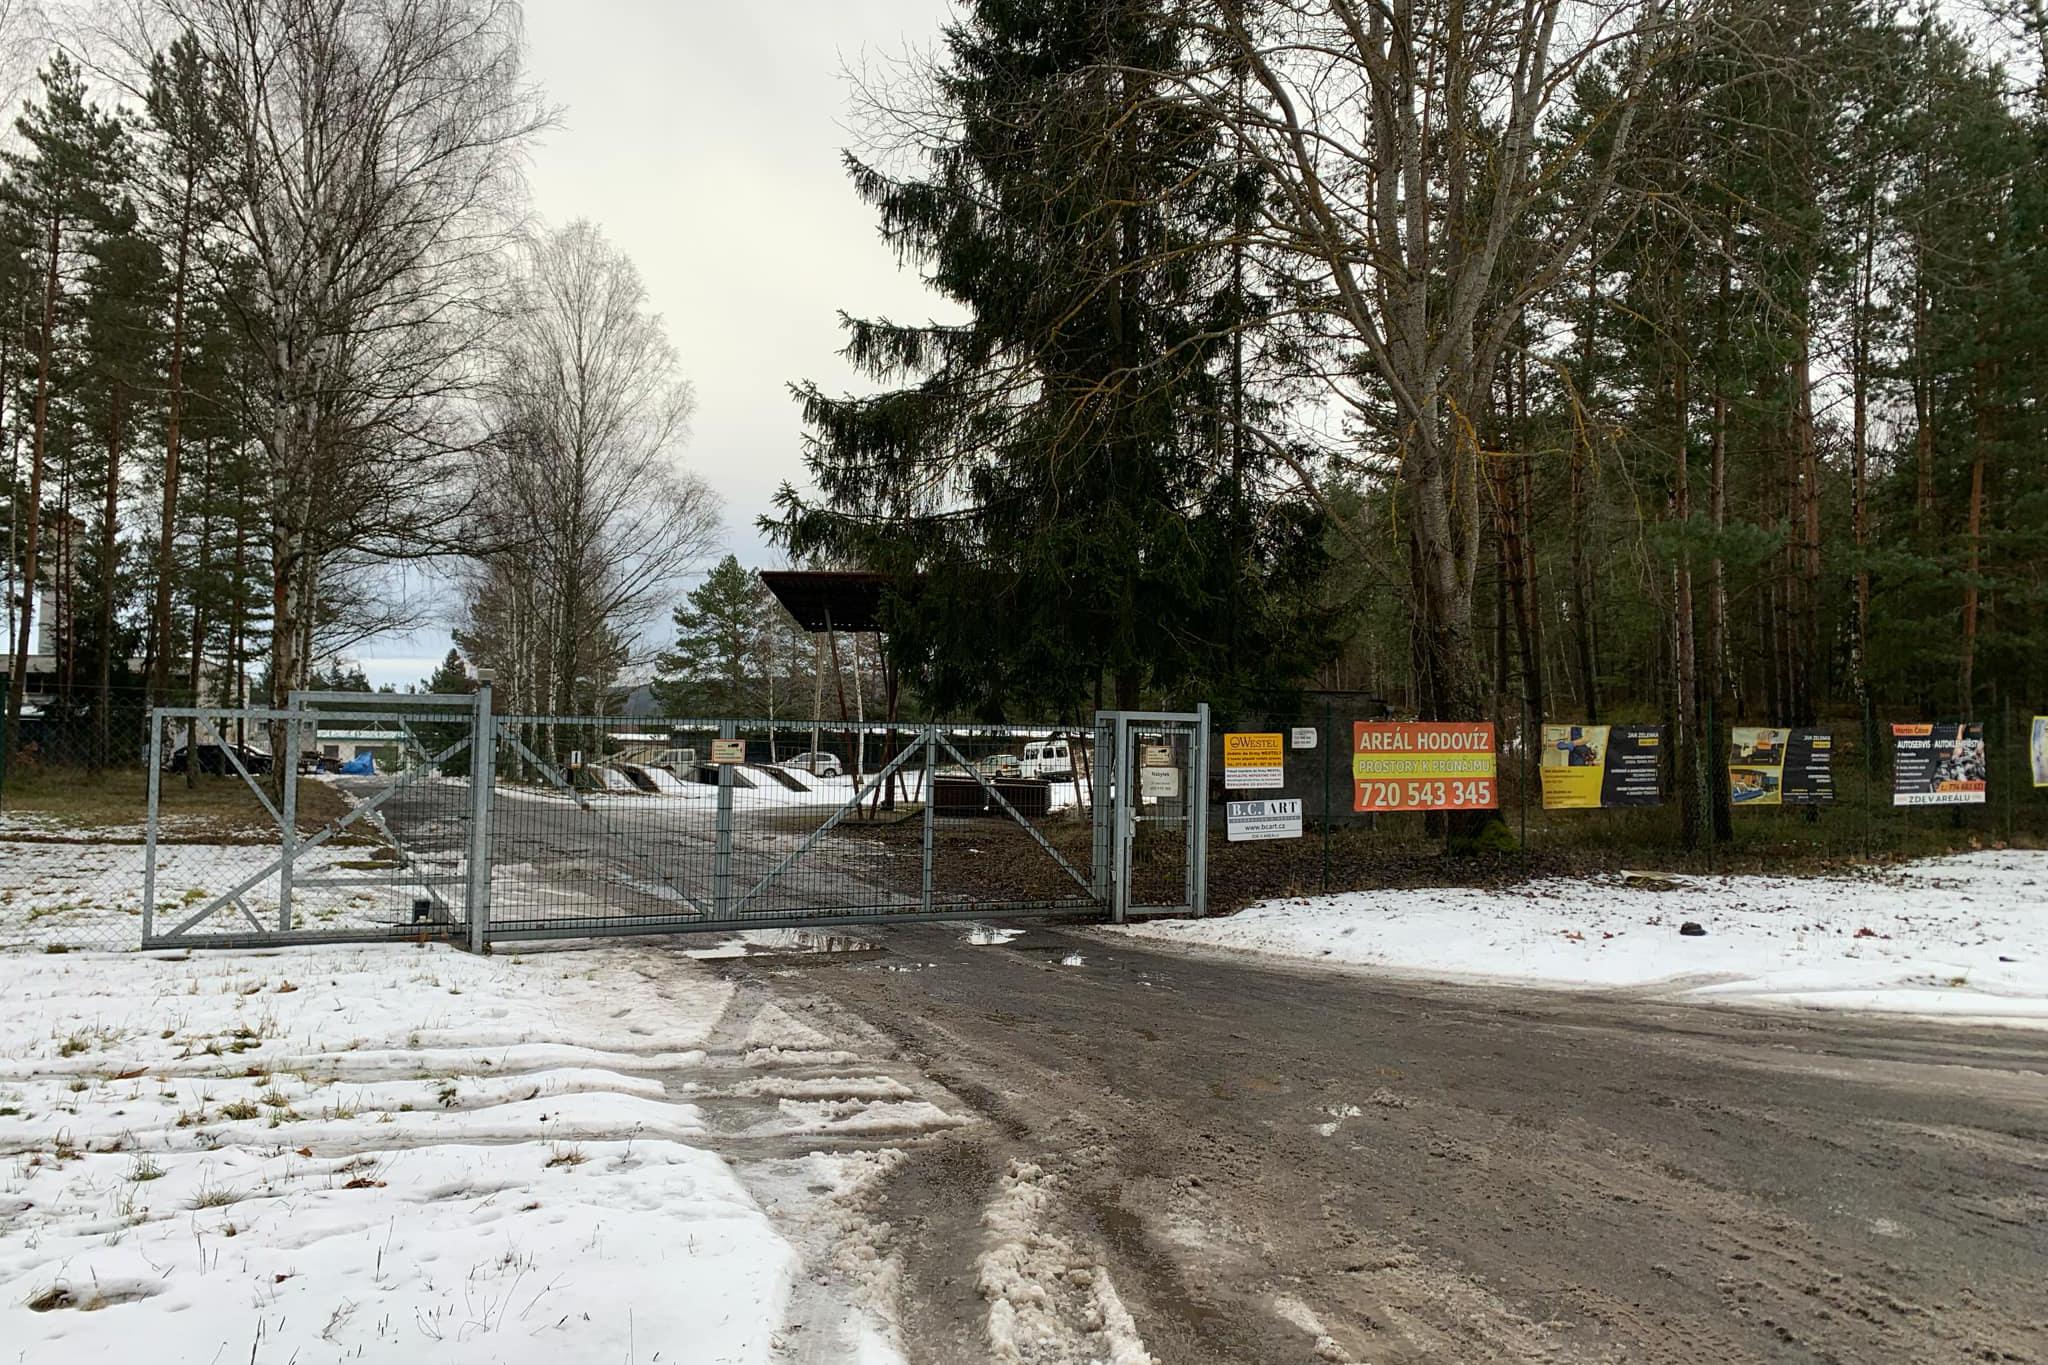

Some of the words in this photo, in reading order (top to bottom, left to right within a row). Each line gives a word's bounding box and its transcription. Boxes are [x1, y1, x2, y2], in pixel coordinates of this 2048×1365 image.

[1360, 727, 1413, 750] AREÁL
[1418, 727, 1489, 750] HODOVÍZ
[1359, 760, 1418, 773] PROSTORY
[1422, 760, 1429, 772] K
[1433, 756, 1490, 772] PRONÁJMU
[1360, 782, 1401, 807] 720
[1408, 781, 1446, 806] 543
[1453, 781, 1491, 805] 345
[1232, 803, 1262, 816] B.C.
[1269, 801, 1297, 814] ART
[1245, 823, 1285, 832] www.bcart.cz
